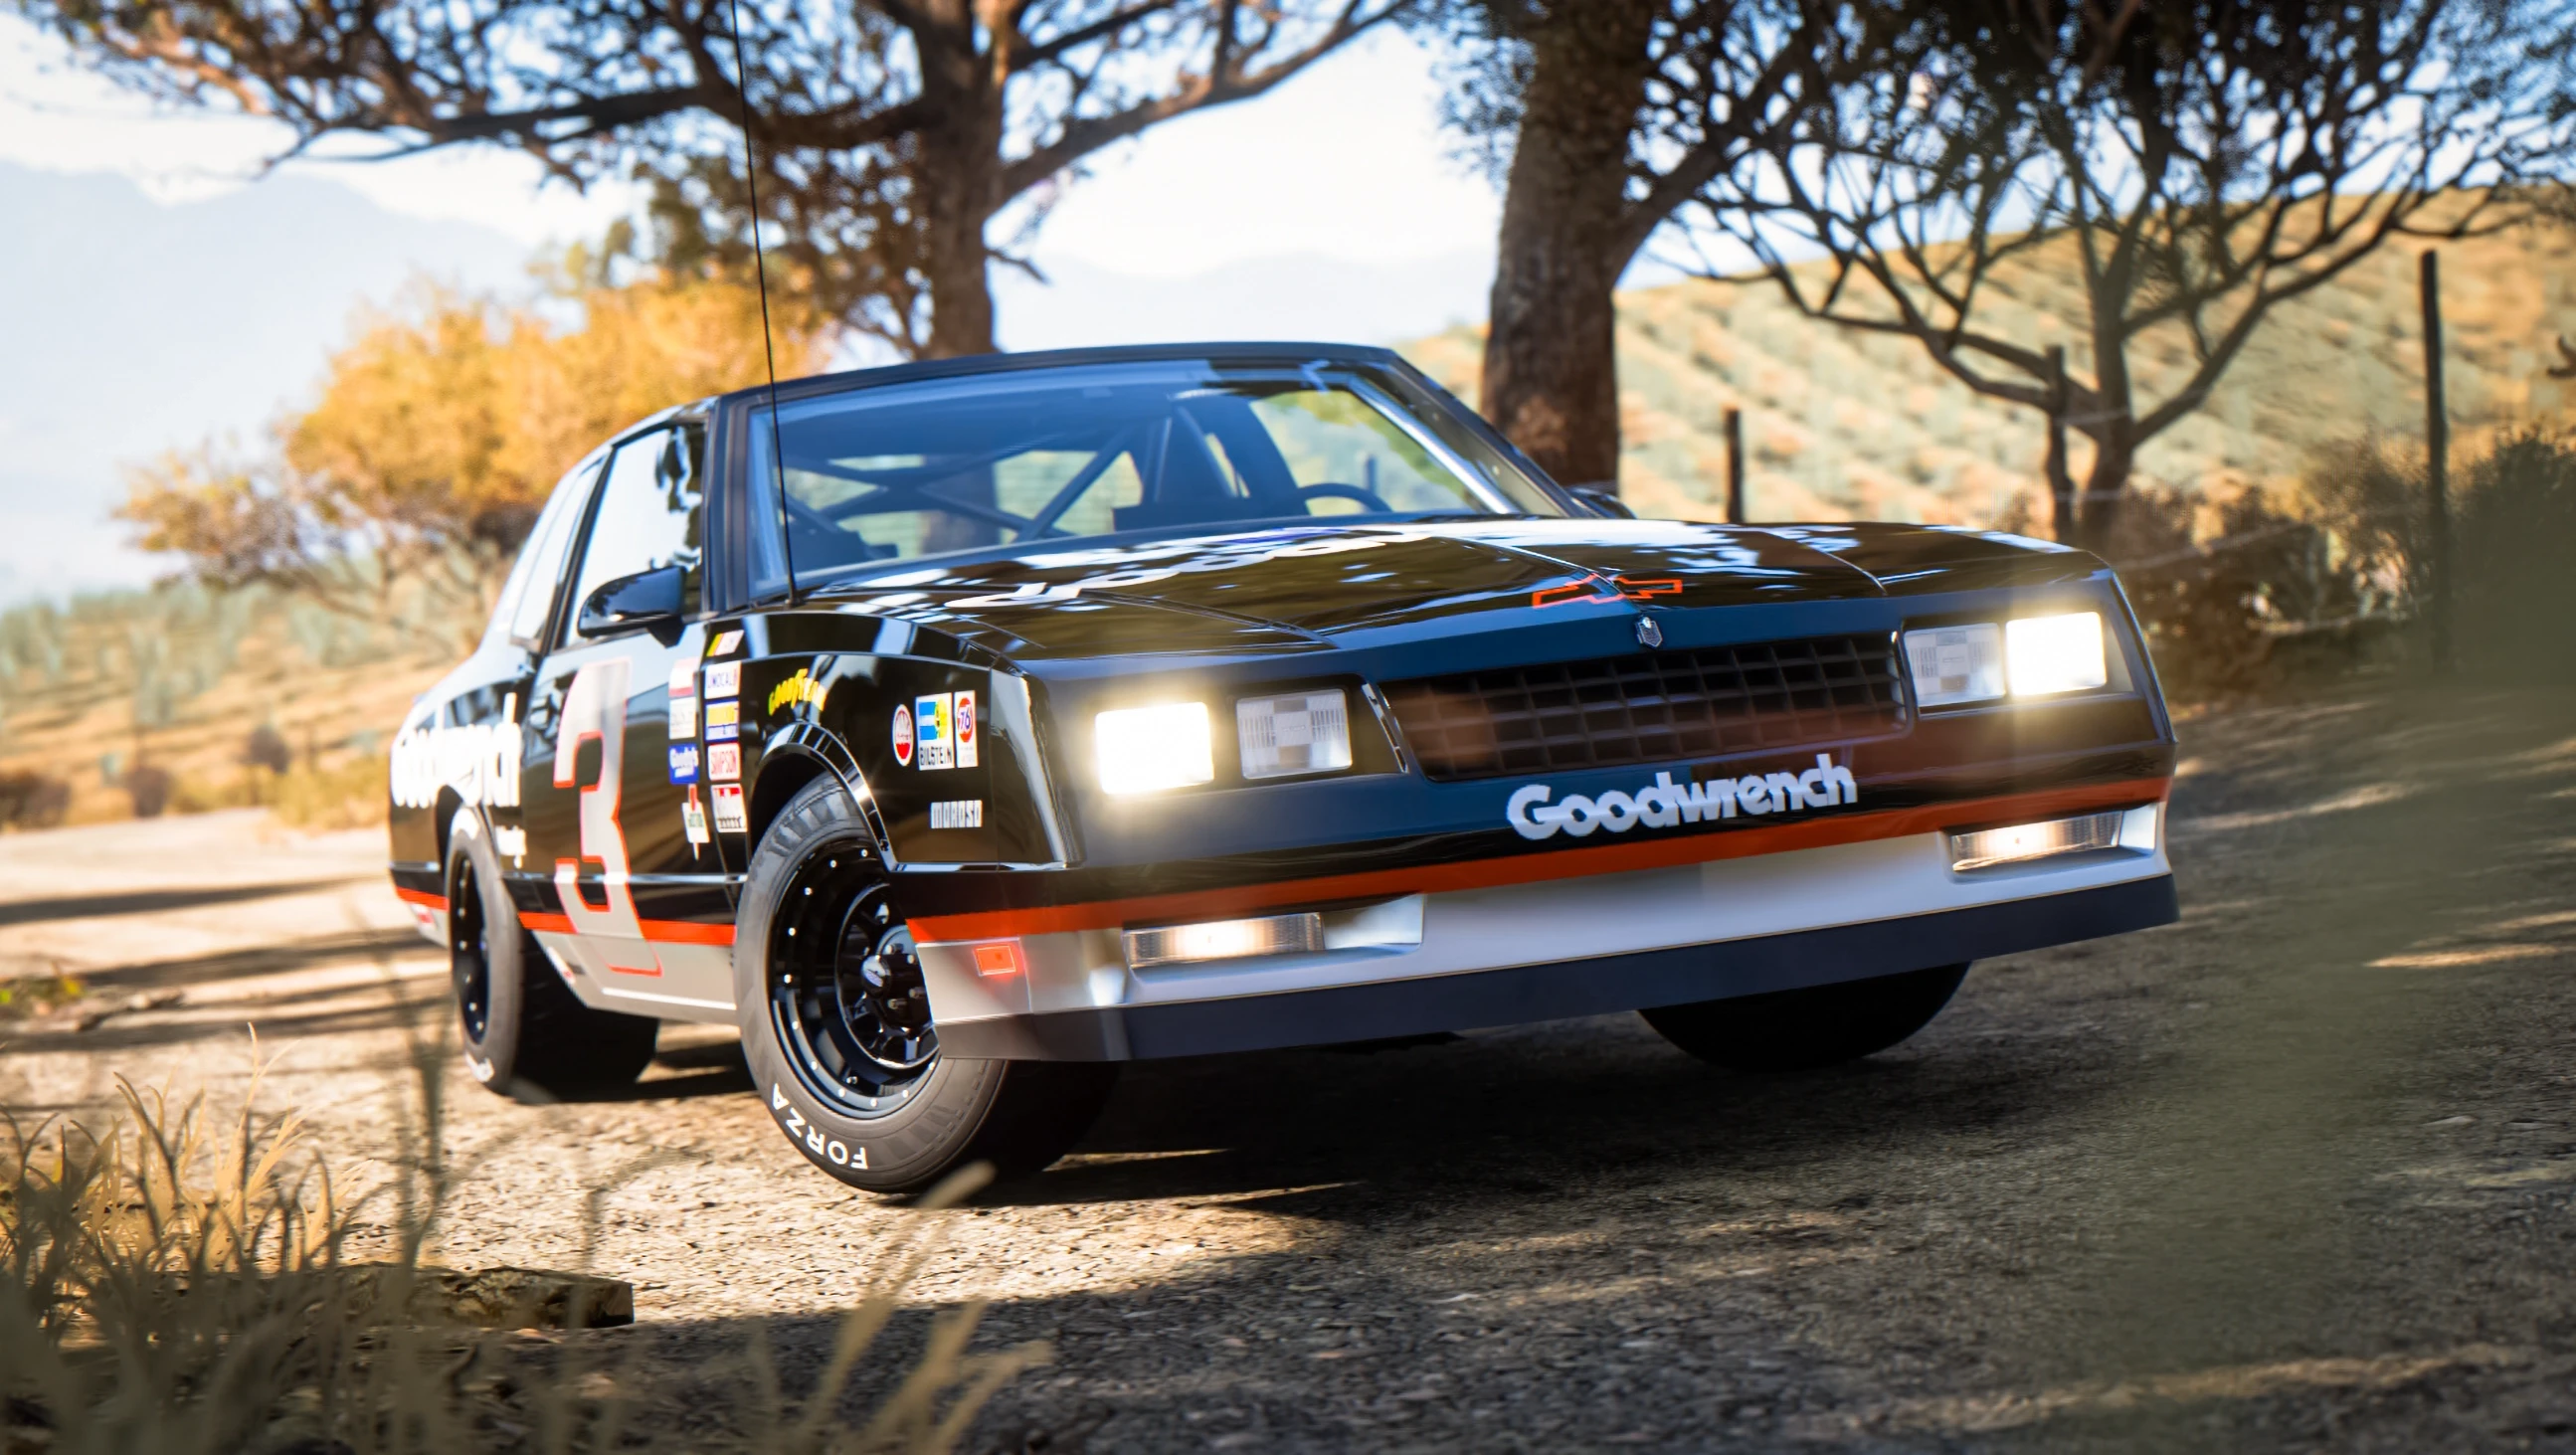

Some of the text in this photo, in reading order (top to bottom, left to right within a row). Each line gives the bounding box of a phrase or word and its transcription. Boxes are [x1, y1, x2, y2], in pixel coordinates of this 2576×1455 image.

[919, 746, 952, 766] BILSTEIN
[960, 706, 971, 730] 76
[554, 656, 663, 978] 3
[1506, 753, 1858, 840] Goodwrench
[772, 1083, 868, 1170] FORZA
